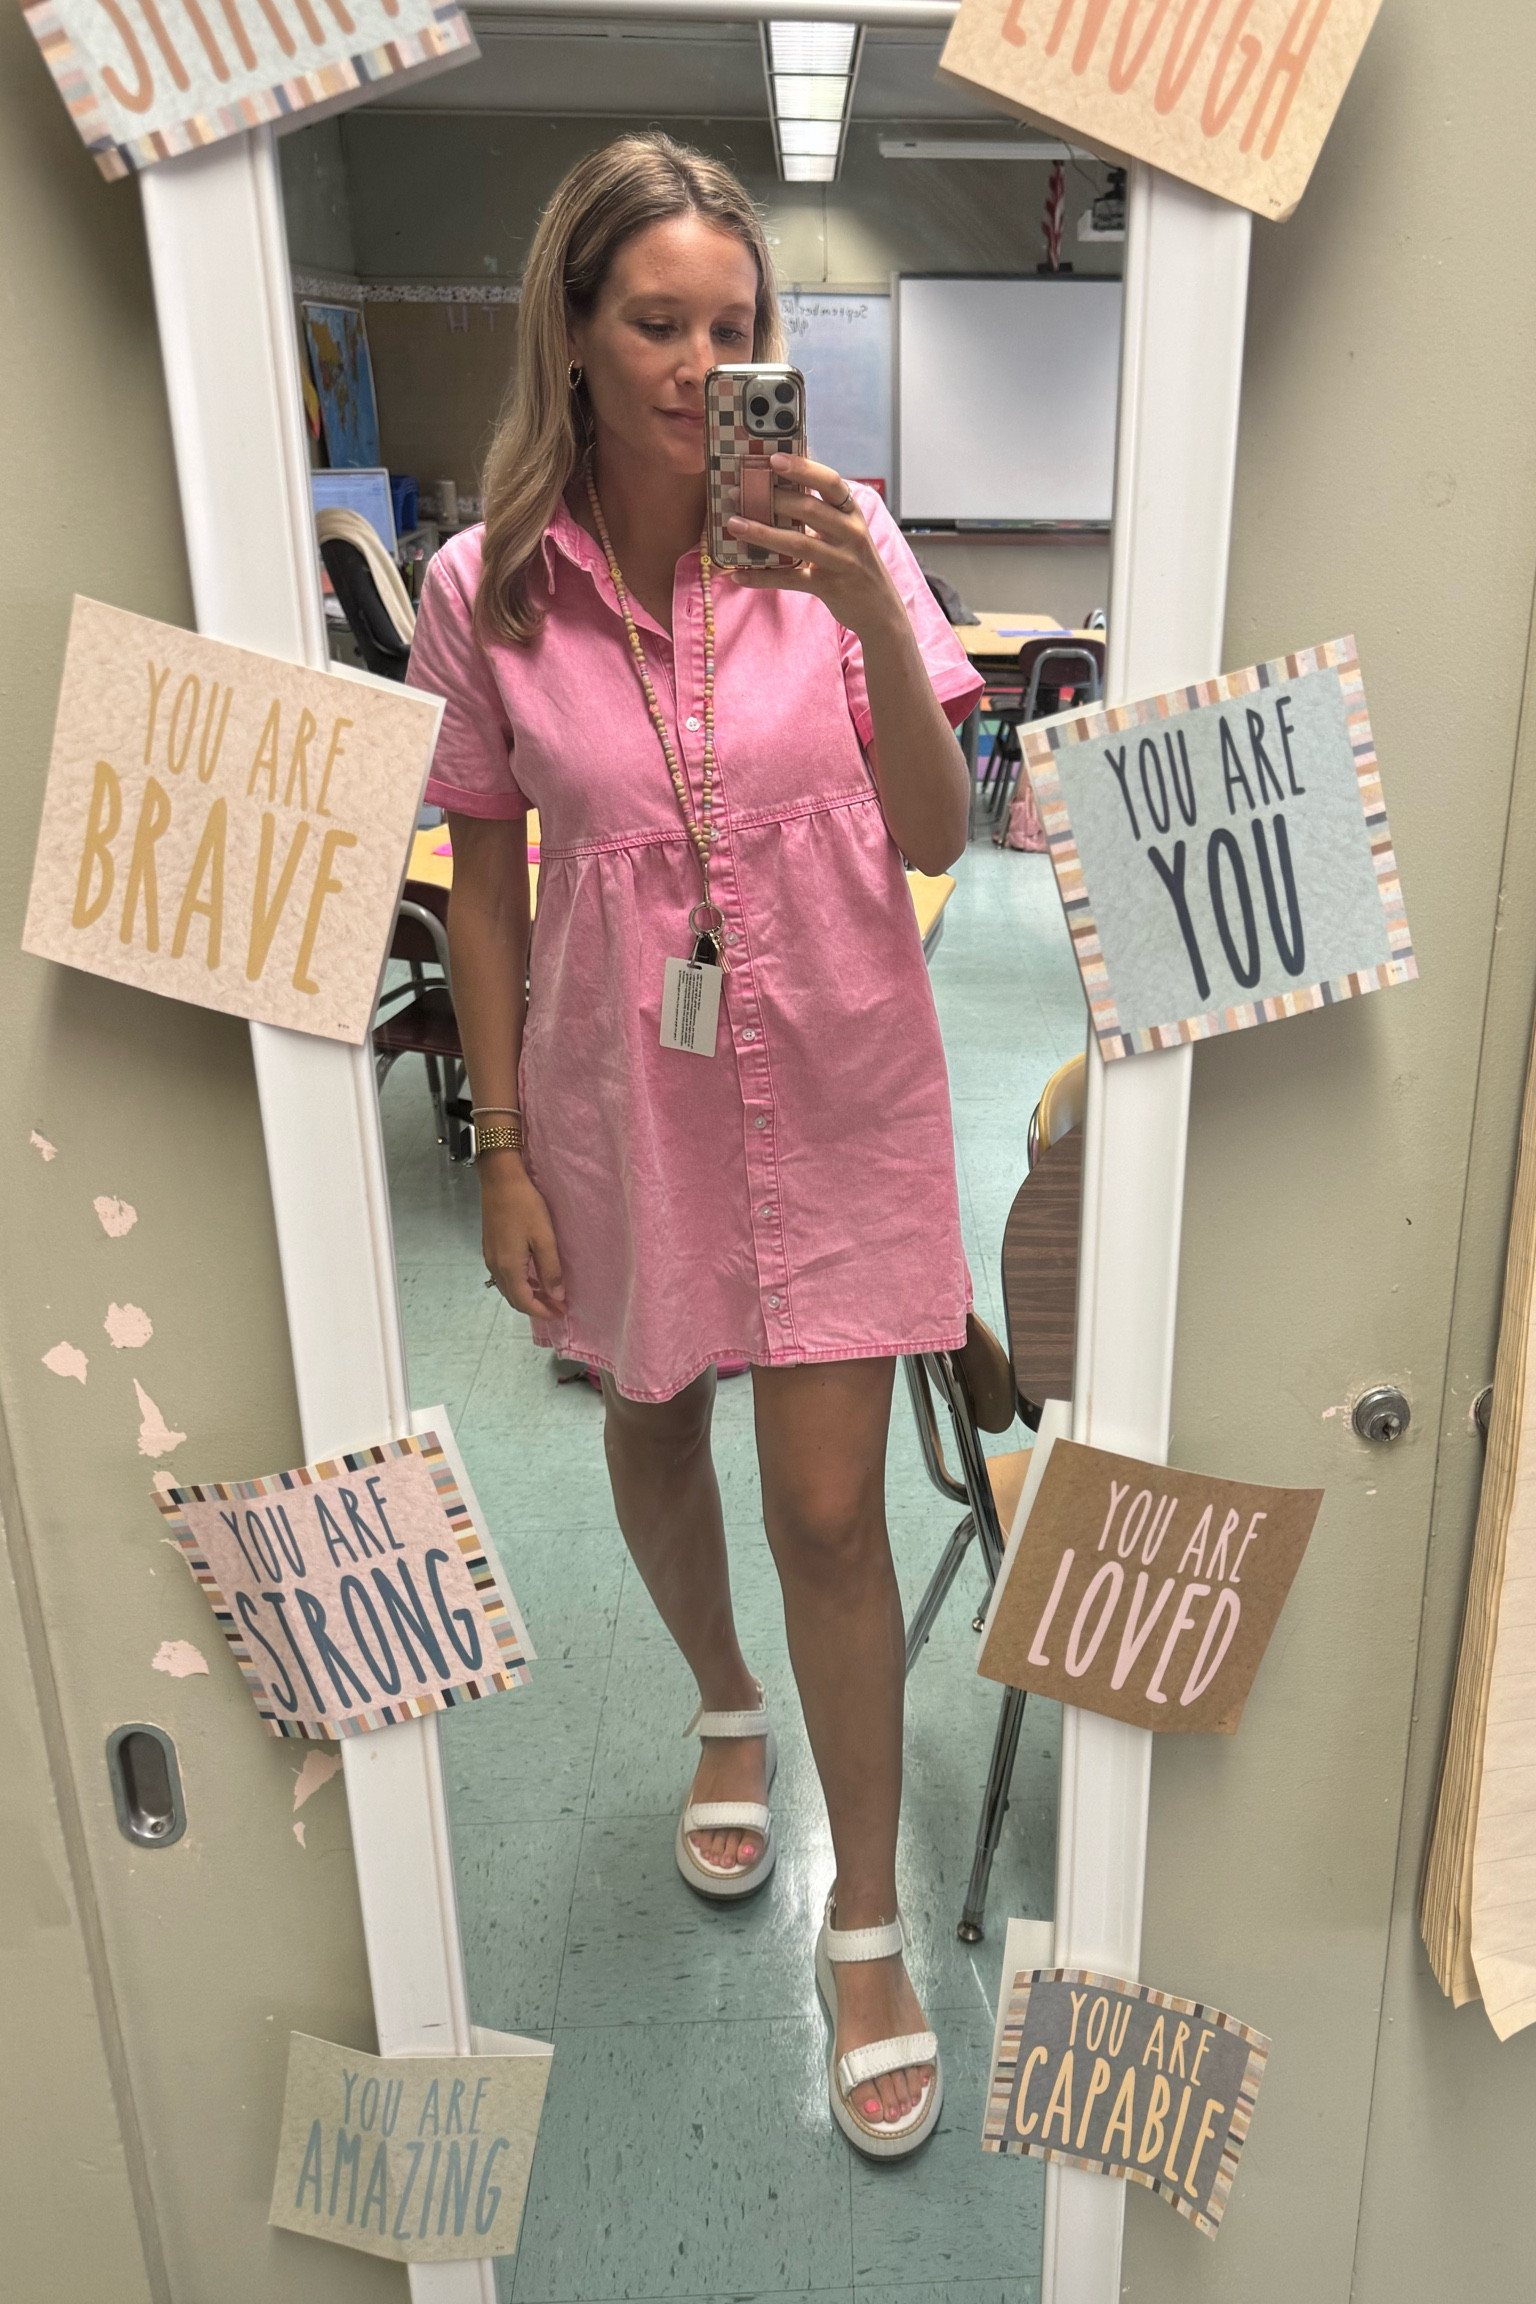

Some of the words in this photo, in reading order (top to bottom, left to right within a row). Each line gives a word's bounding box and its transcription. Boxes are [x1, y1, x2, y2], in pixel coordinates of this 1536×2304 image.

[1001, 0, 1332, 161] UGH
[145, 660, 234, 784] YOU
[247, 700, 354, 818] ARE
[1104, 729, 1197, 841] YOU
[1219, 695, 1306, 815] ARE
[71, 760, 357, 995] BRAVE
[1147, 813, 1306, 1001] YOU
[219, 1504, 306, 1584] YOU
[314, 1476, 405, 1567] ARE
[1098, 1480, 1178, 1565] YOU
[1177, 1504, 1267, 1583] ARE
[235, 1548, 483, 1714] STRONG
[1027, 1548, 1241, 1706] LOVED
[343, 2068, 404, 2138] YOU
[417, 2076, 491, 2137] ARE
[1069, 1990, 1133, 2057] YOU
[1142, 2015, 1216, 2087] ARE
[295, 2117, 511, 2241] AMAZING
[1015, 2046, 1225, 2198] CAPABLE
